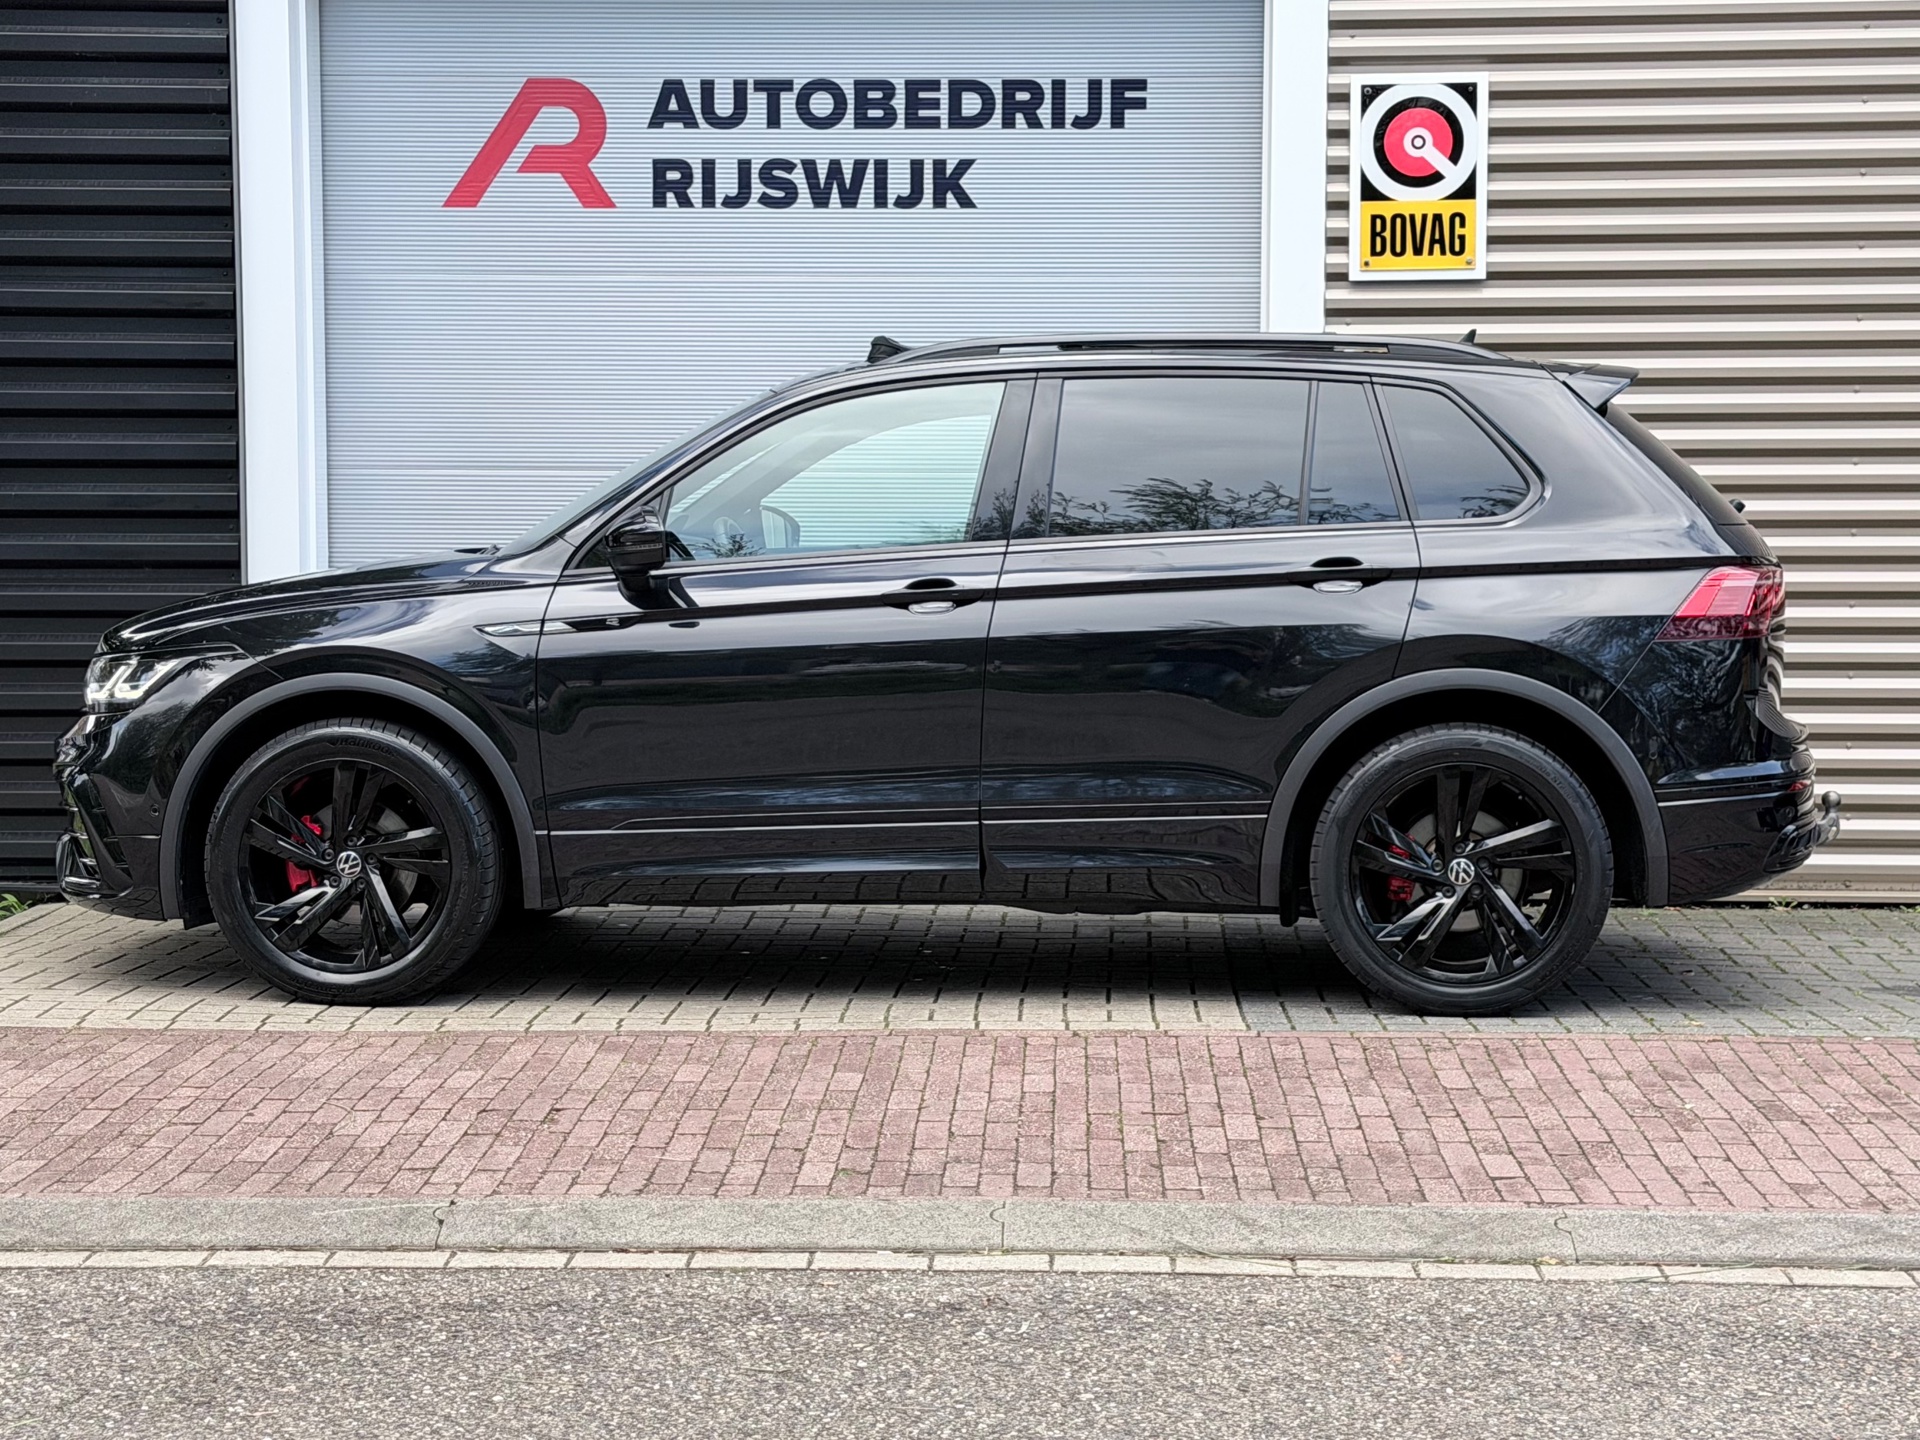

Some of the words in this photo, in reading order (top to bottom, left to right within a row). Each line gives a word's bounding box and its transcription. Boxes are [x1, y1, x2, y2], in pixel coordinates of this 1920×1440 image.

[648, 79, 1147, 129] AUTOBEDRIJF
[653, 159, 976, 209] RIJSWIJK
[1370, 212, 1465, 257] BOVAG
